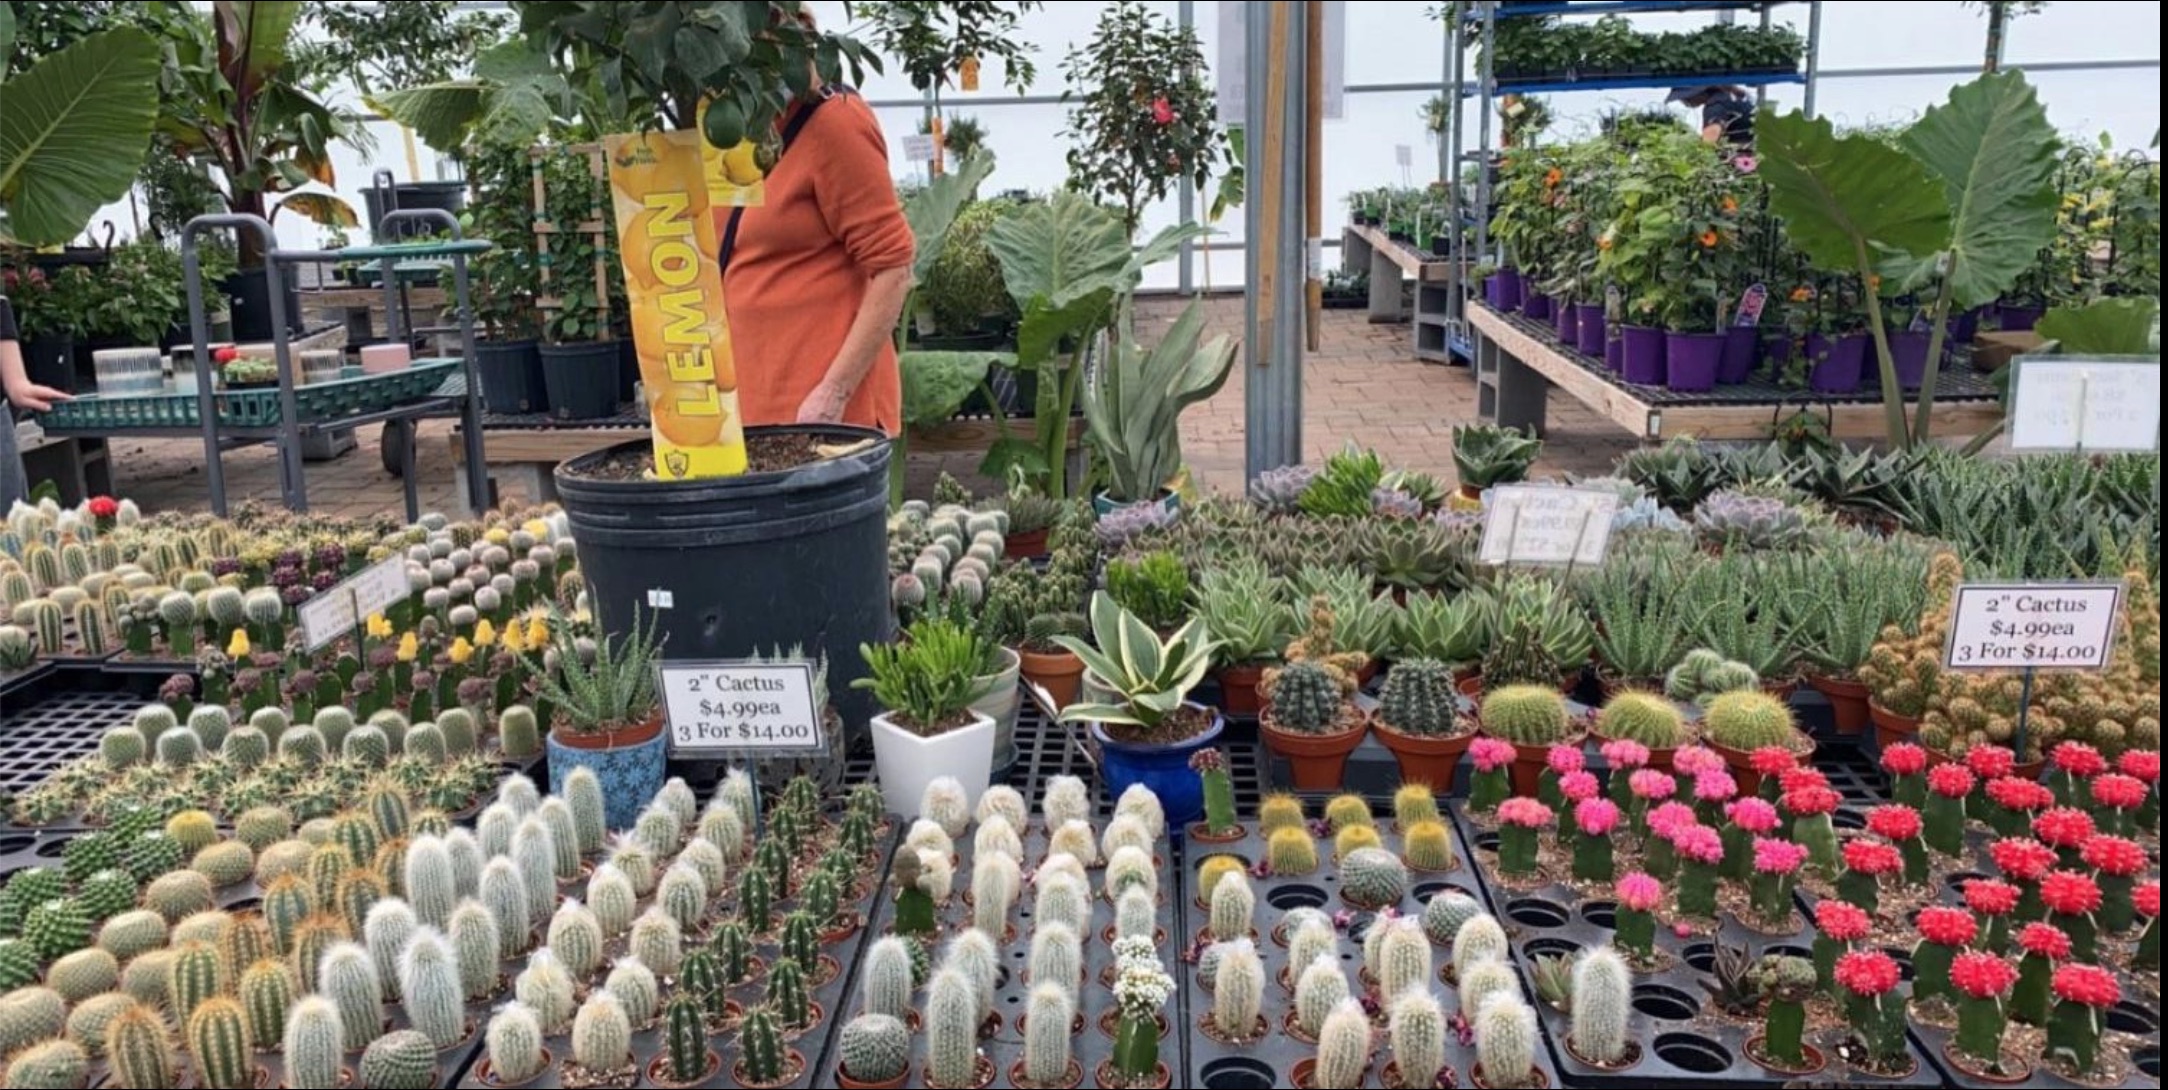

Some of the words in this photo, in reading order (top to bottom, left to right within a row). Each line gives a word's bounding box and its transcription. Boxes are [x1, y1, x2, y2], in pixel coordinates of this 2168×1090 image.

[644, 191, 721, 416] LEMON
[1985, 595, 2011, 613] 2"
[2015, 595, 2088, 613] Cactus
[1989, 619, 2075, 638] $4.99ea
[1958, 645, 1972, 662] 3
[1980, 642, 2017, 659] For
[2022, 642, 2096, 661] $14.00
[688, 674, 709, 692] 2"
[715, 674, 785, 692] Cactus
[700, 699, 781, 719] $4.99ea
[679, 725, 691, 742] 3
[697, 722, 732, 738] For
[738, 721, 808, 741] $14.00
